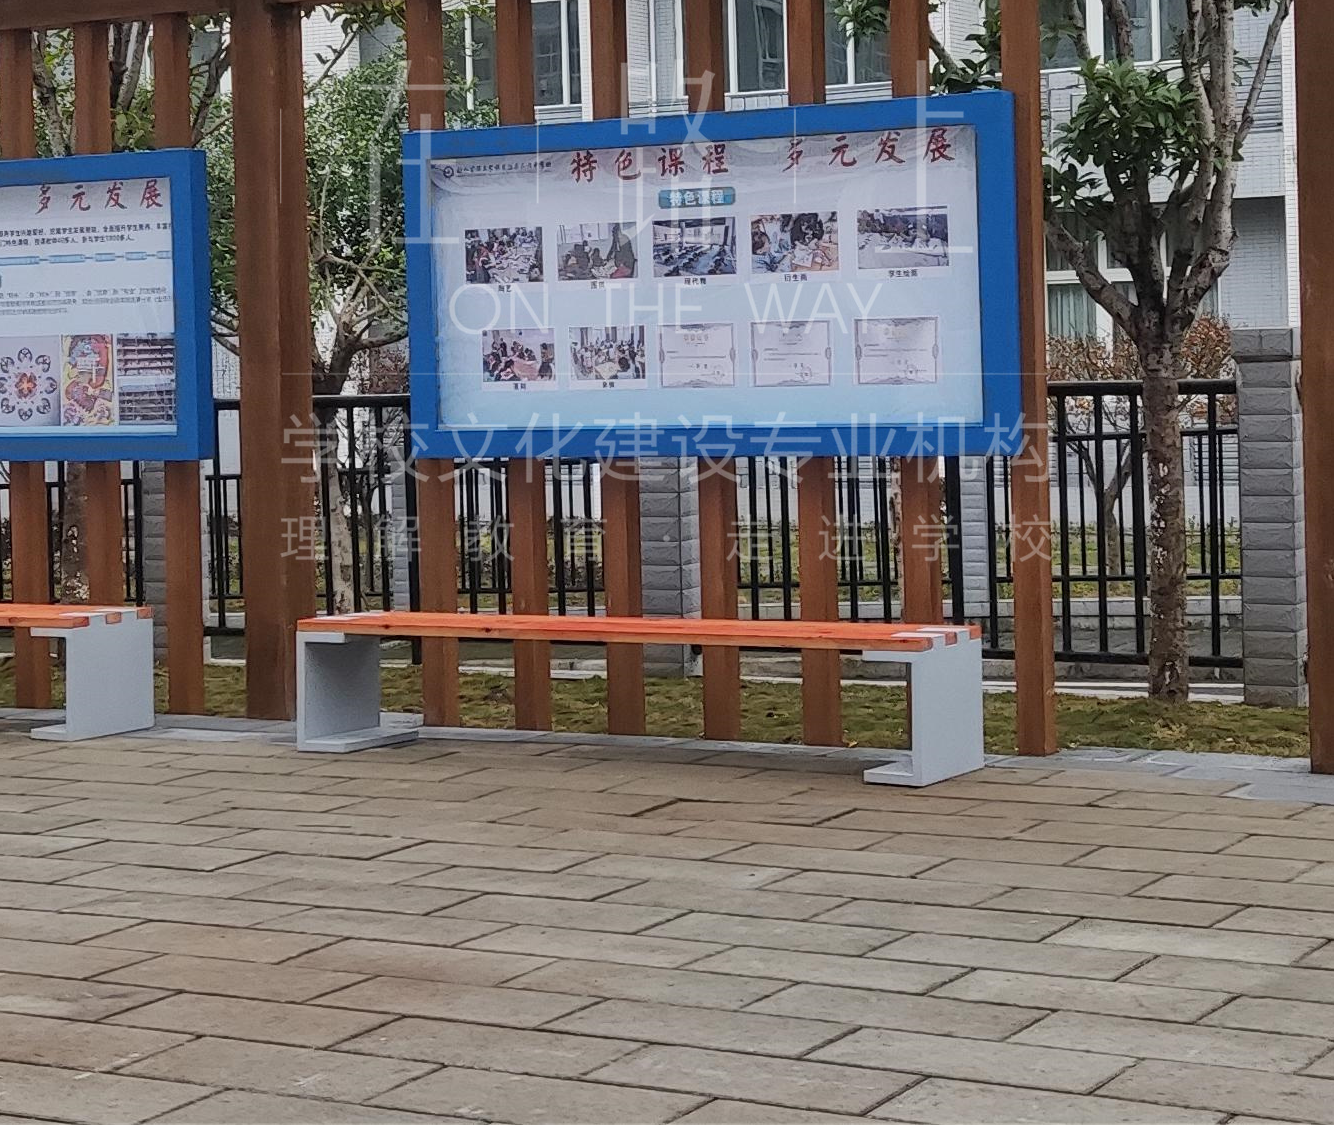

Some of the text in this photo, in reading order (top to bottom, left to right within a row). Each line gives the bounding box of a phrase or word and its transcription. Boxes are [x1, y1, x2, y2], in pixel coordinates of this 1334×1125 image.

[571, 128, 955, 183] 特色课程 多元发展
[35, 179, 164, 215] 多元发展
